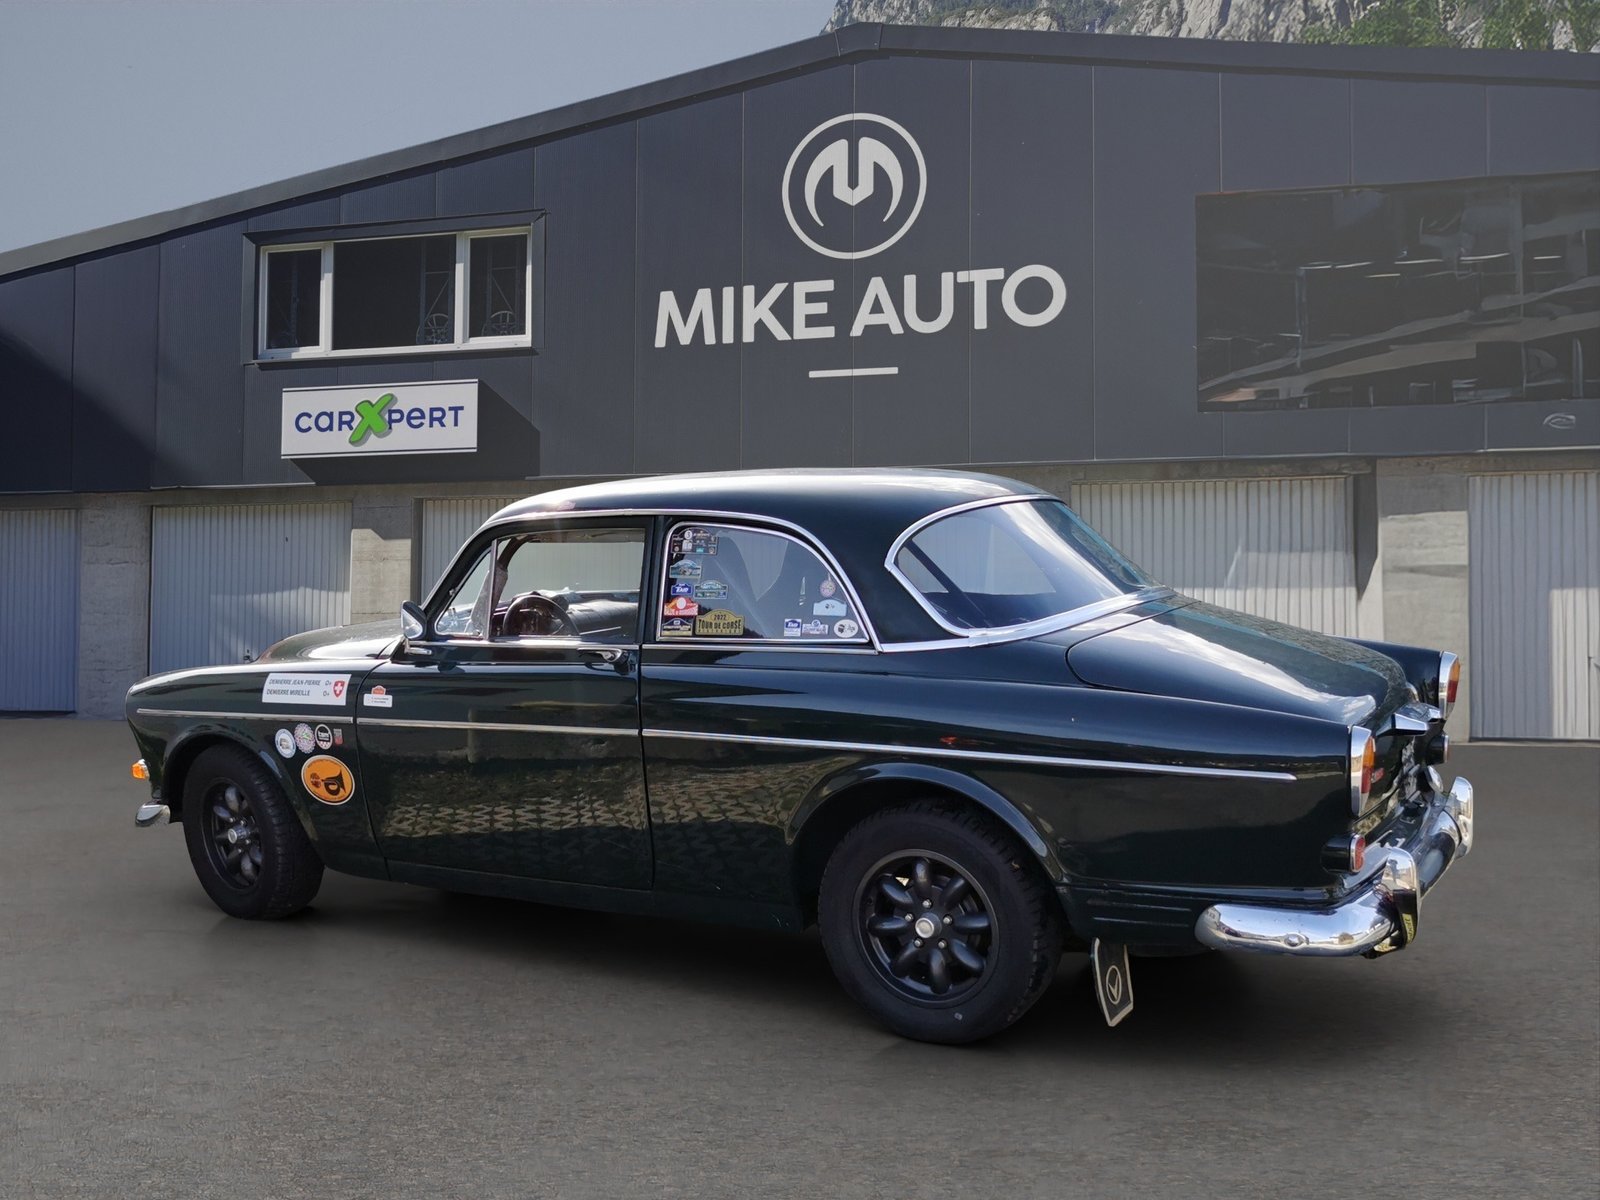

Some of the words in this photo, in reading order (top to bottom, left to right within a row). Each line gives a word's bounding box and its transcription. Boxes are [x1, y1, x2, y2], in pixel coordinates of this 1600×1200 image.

[654, 279, 836, 348] MIKE
[849, 264, 1067, 338] AUTO
[698, 619, 713, 629] TOUR
[714, 622, 722, 630] DE
[722, 619, 742, 630] CORSE
